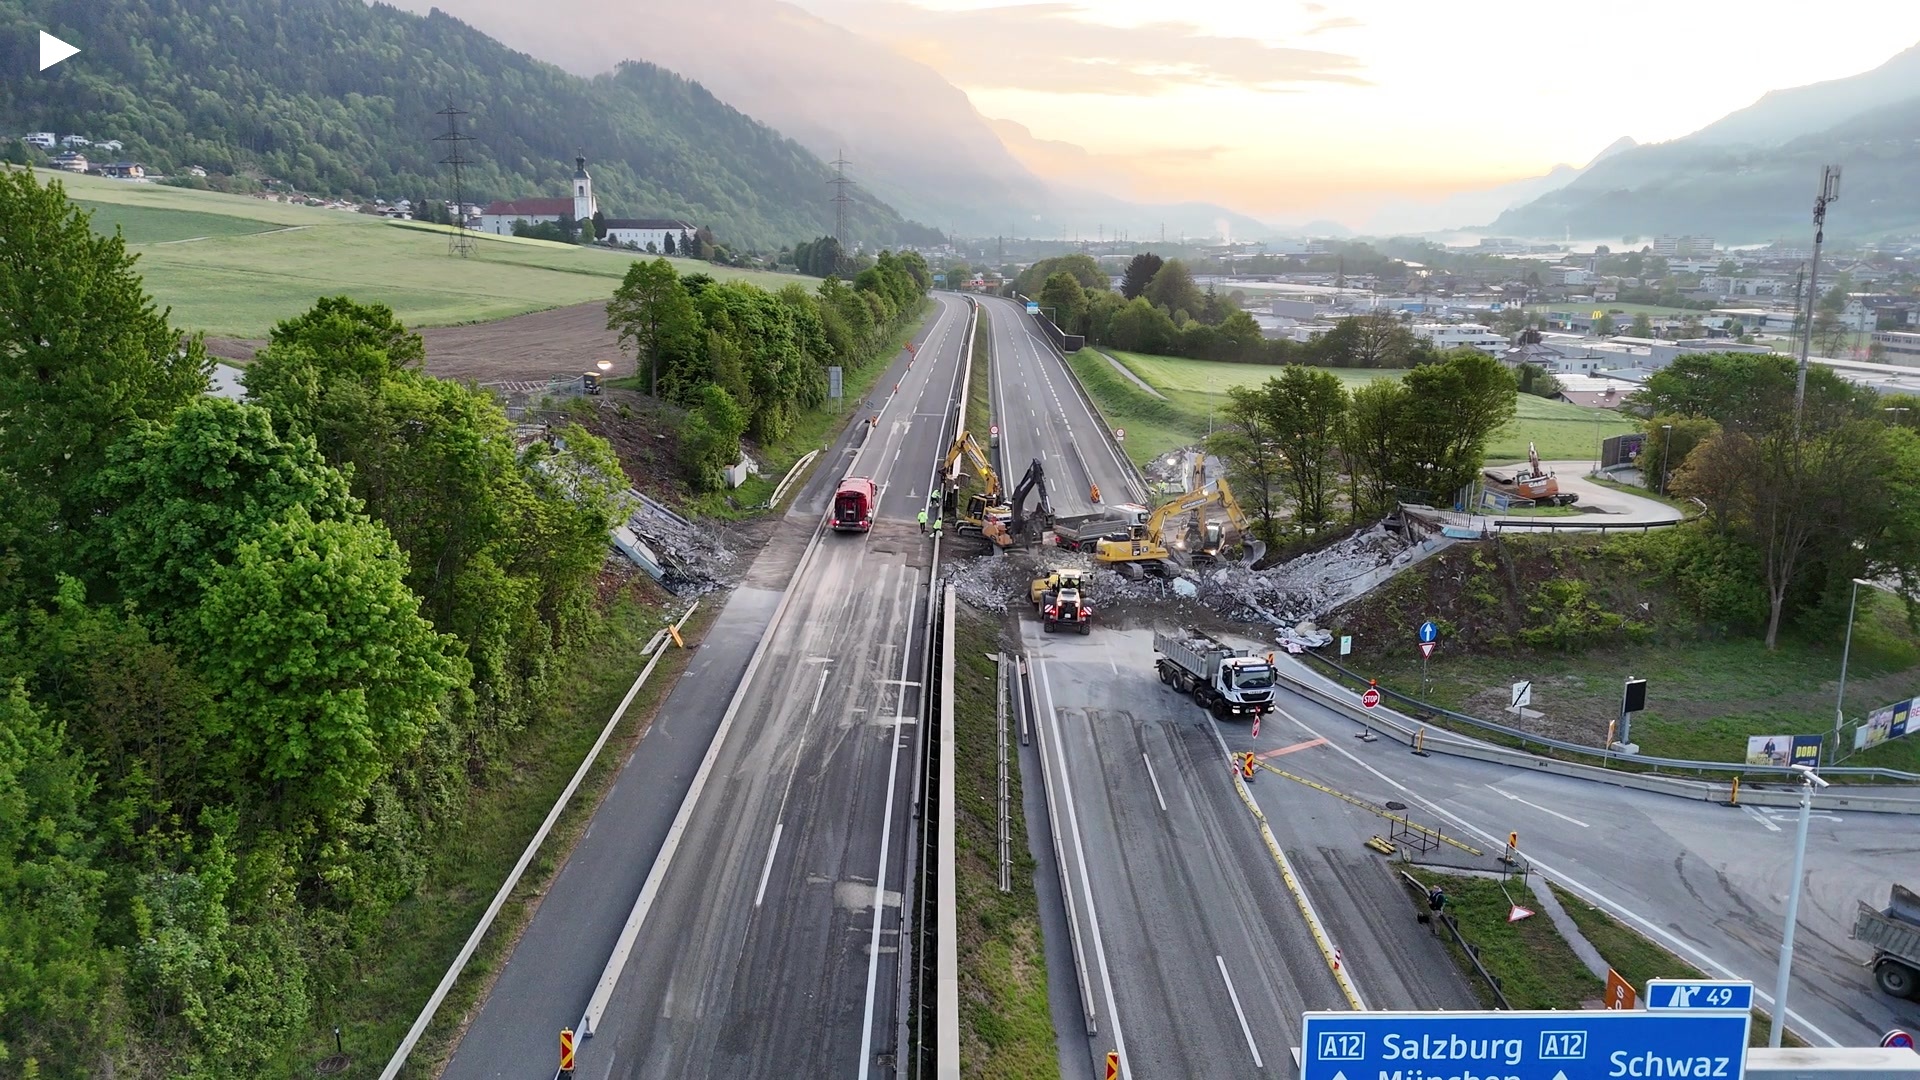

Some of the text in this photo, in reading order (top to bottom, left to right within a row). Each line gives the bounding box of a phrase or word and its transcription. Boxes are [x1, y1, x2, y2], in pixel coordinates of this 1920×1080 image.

[1364, 695, 1378, 703] STOP
[1706, 988, 1733, 1006] 49
[1323, 1033, 1523, 1066] A12 Salzburg
[1544, 1034, 1582, 1056] A12
[1608, 1050, 1730, 1078] Schwaz
